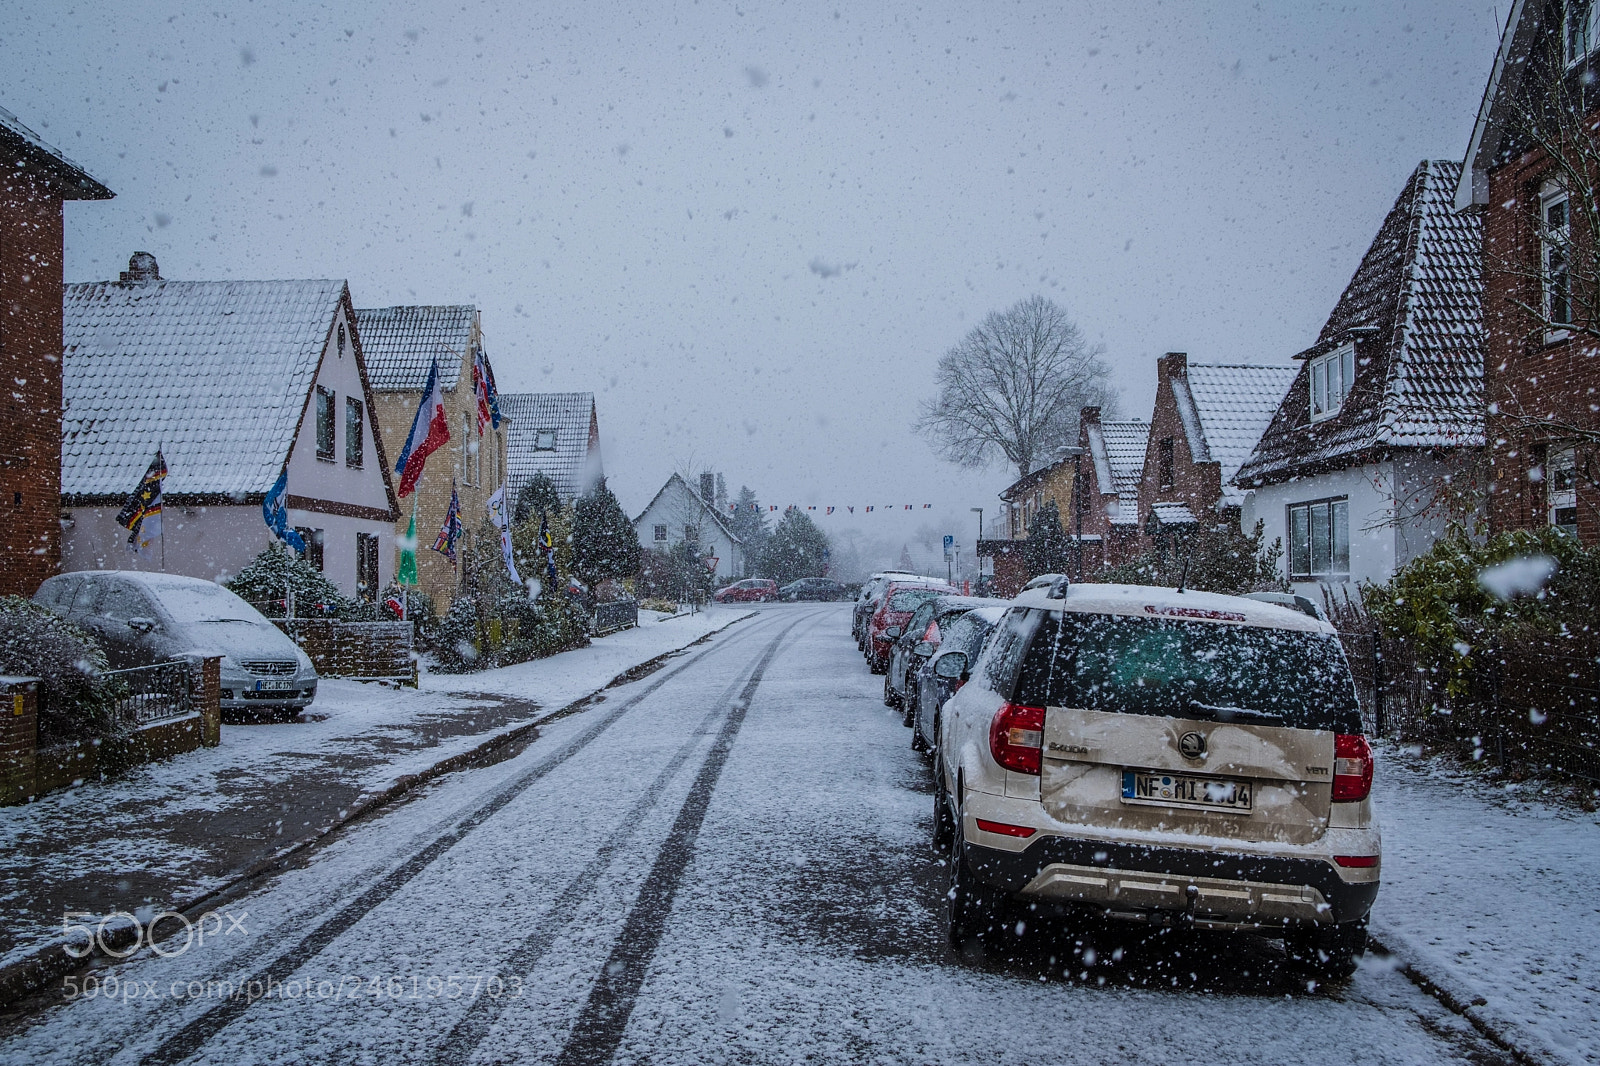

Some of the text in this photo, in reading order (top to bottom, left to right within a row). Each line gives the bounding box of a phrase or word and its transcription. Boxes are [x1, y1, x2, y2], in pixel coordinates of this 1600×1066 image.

[1306, 766, 1328, 775] YETI
[1137, 776, 1248, 805] NF MI 204
